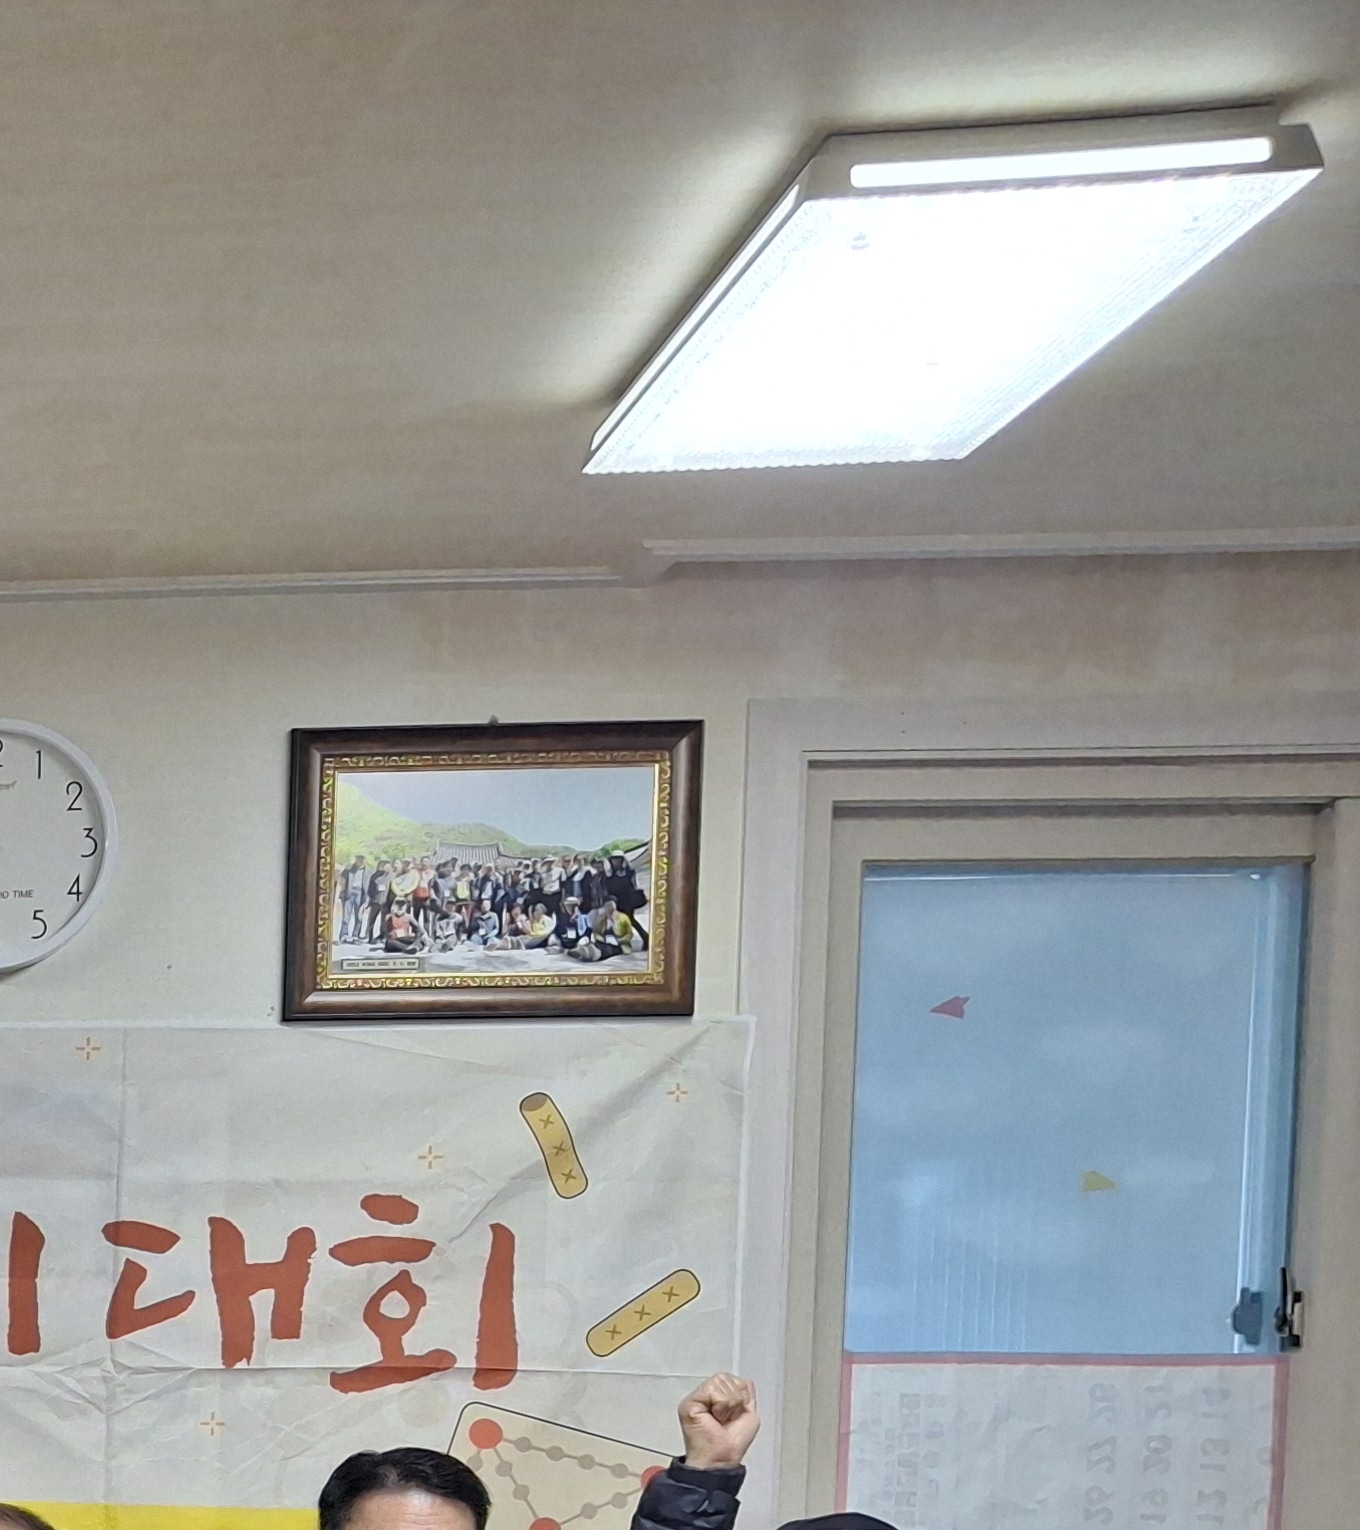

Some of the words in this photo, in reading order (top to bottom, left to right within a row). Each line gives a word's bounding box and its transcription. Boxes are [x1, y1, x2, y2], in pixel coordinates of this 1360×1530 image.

[35, 750, 43, 780] 1
[66, 781, 83, 811] 2
[81, 828, 98, 858] 3
[13, 890, 34, 899] TIME
[67, 874, 83, 902] 4
[31, 909, 48, 939] 5
[102, 1193, 520, 1393] 대회
